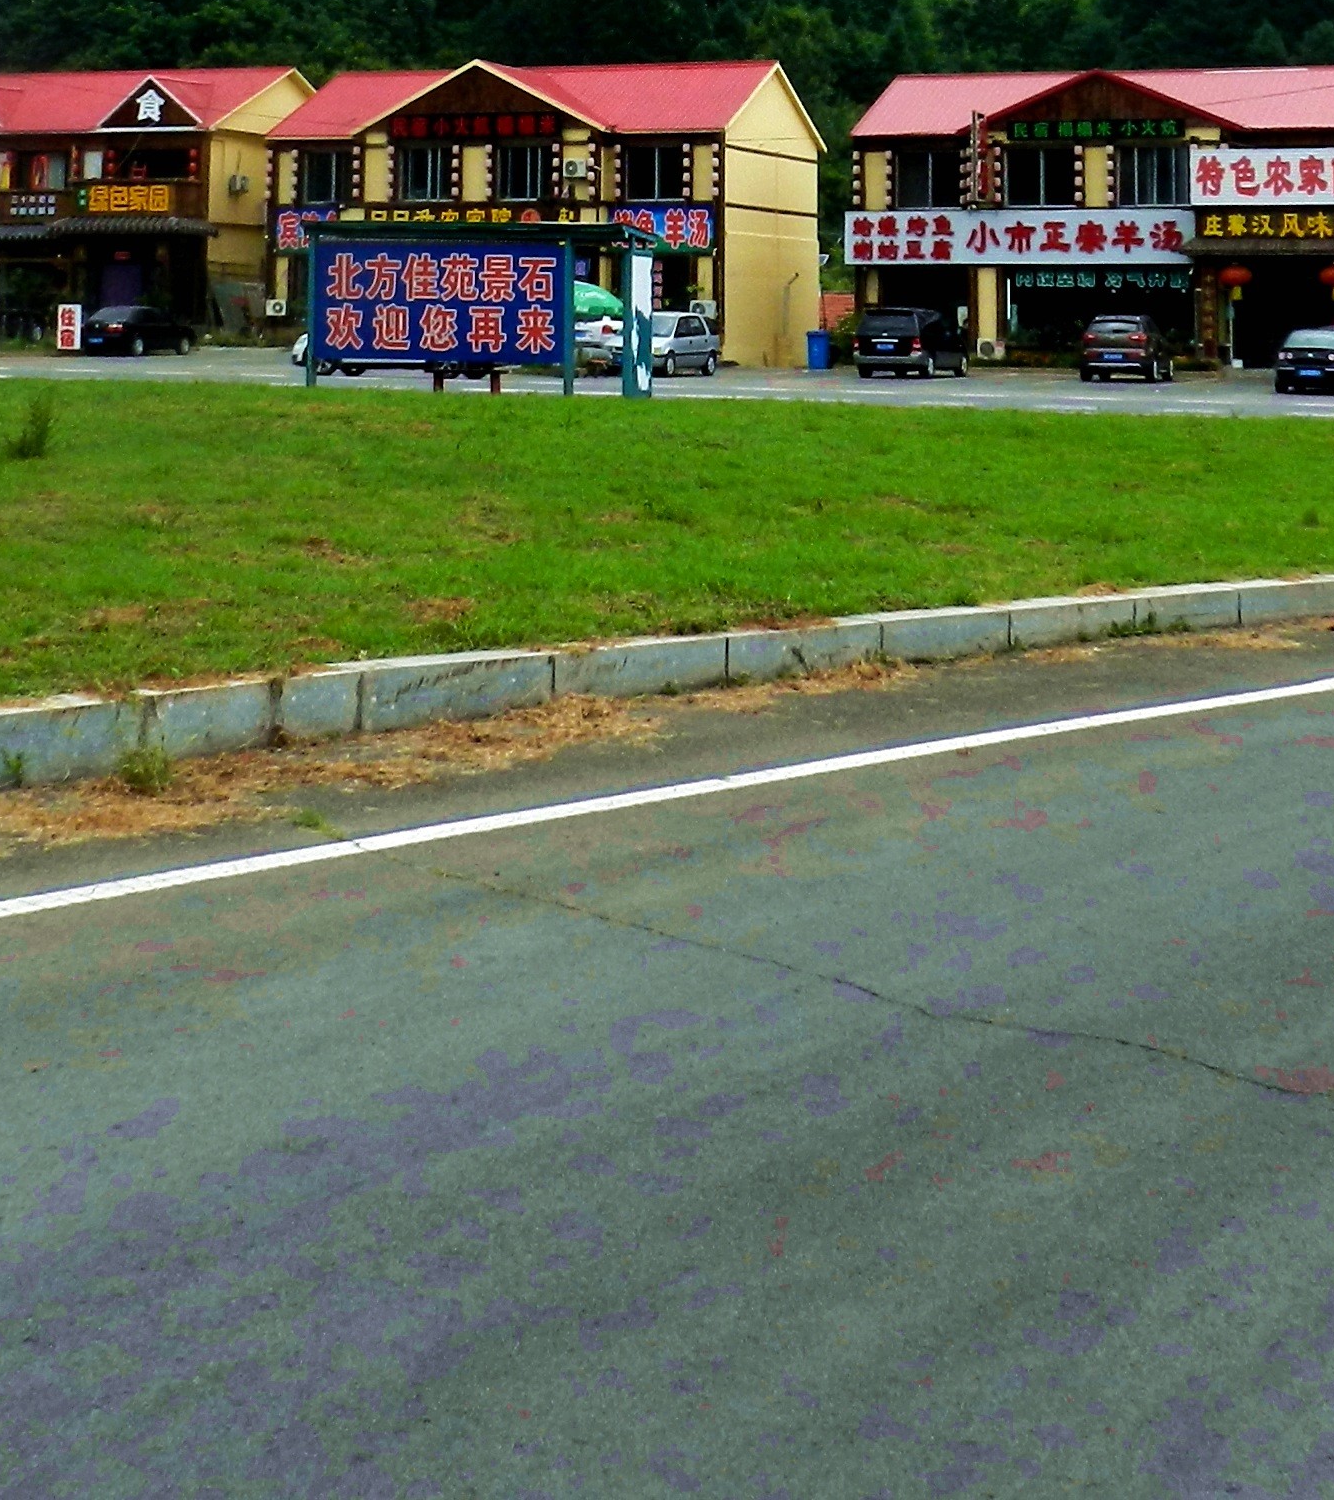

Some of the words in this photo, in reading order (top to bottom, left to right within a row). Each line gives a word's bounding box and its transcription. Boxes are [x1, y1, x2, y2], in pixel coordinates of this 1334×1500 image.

[135, 89, 165, 122] 食
[88, 185, 169, 213] 绿色家园
[965, 219, 1184, 255] 小市正宗羊汤
[326, 252, 557, 302] 北方佳苑景石
[60, 307, 76, 347] 住宿
[325, 304, 556, 354] 欢迎您再来
